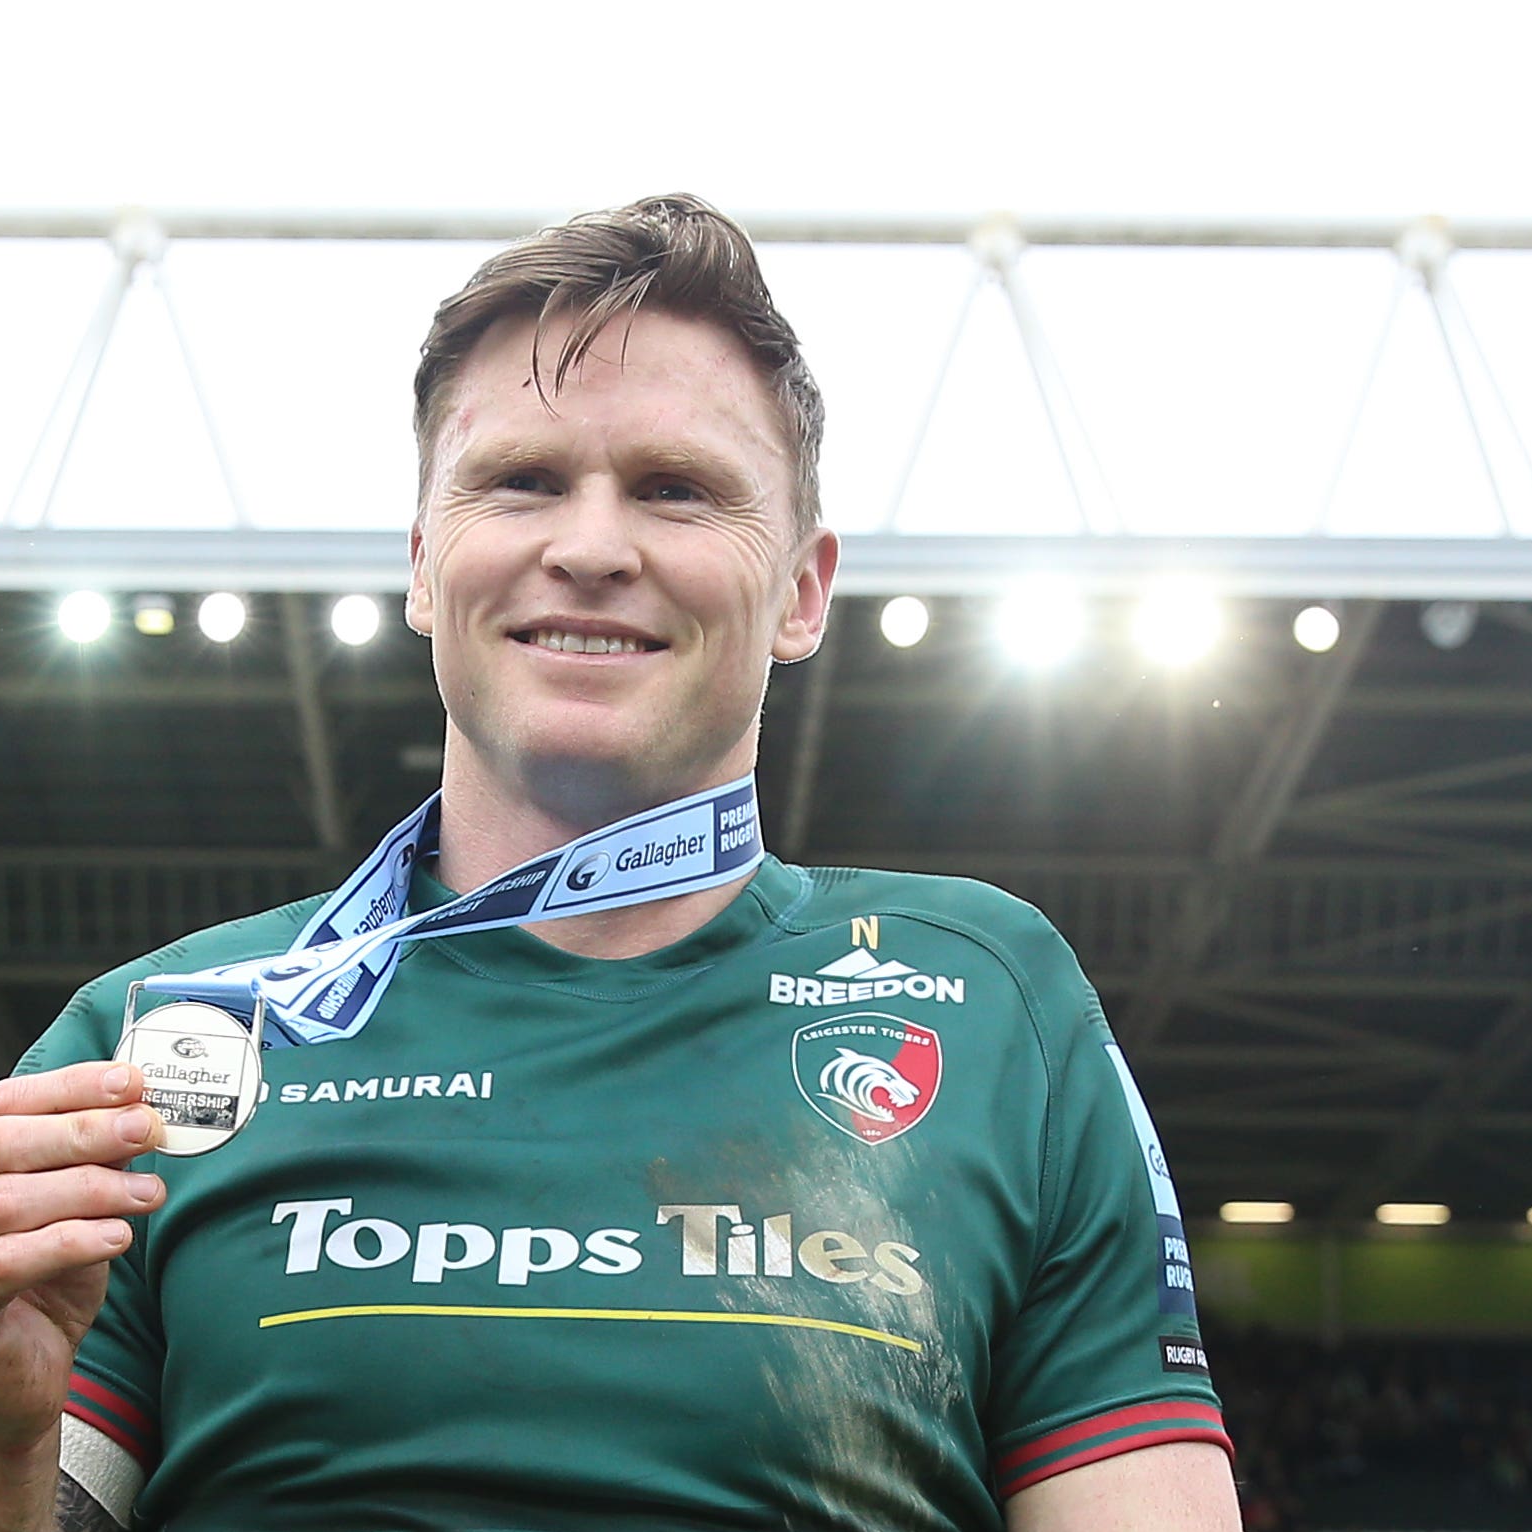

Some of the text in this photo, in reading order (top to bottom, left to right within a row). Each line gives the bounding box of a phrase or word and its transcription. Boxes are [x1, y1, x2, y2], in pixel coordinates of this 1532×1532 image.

[616, 833, 707, 872] Gallagher
[720, 820, 756, 853] RUGBY
[769, 973, 965, 1006] BREEDON
[802, 1025, 931, 1046] LEICESTER TIGERS
[141, 1062, 231, 1085] Gallagher
[279, 1072, 493, 1103] SAMURAI
[141, 1090, 232, 1110] REMIERSHIP
[270, 1197, 924, 1296] Topps Tiles
